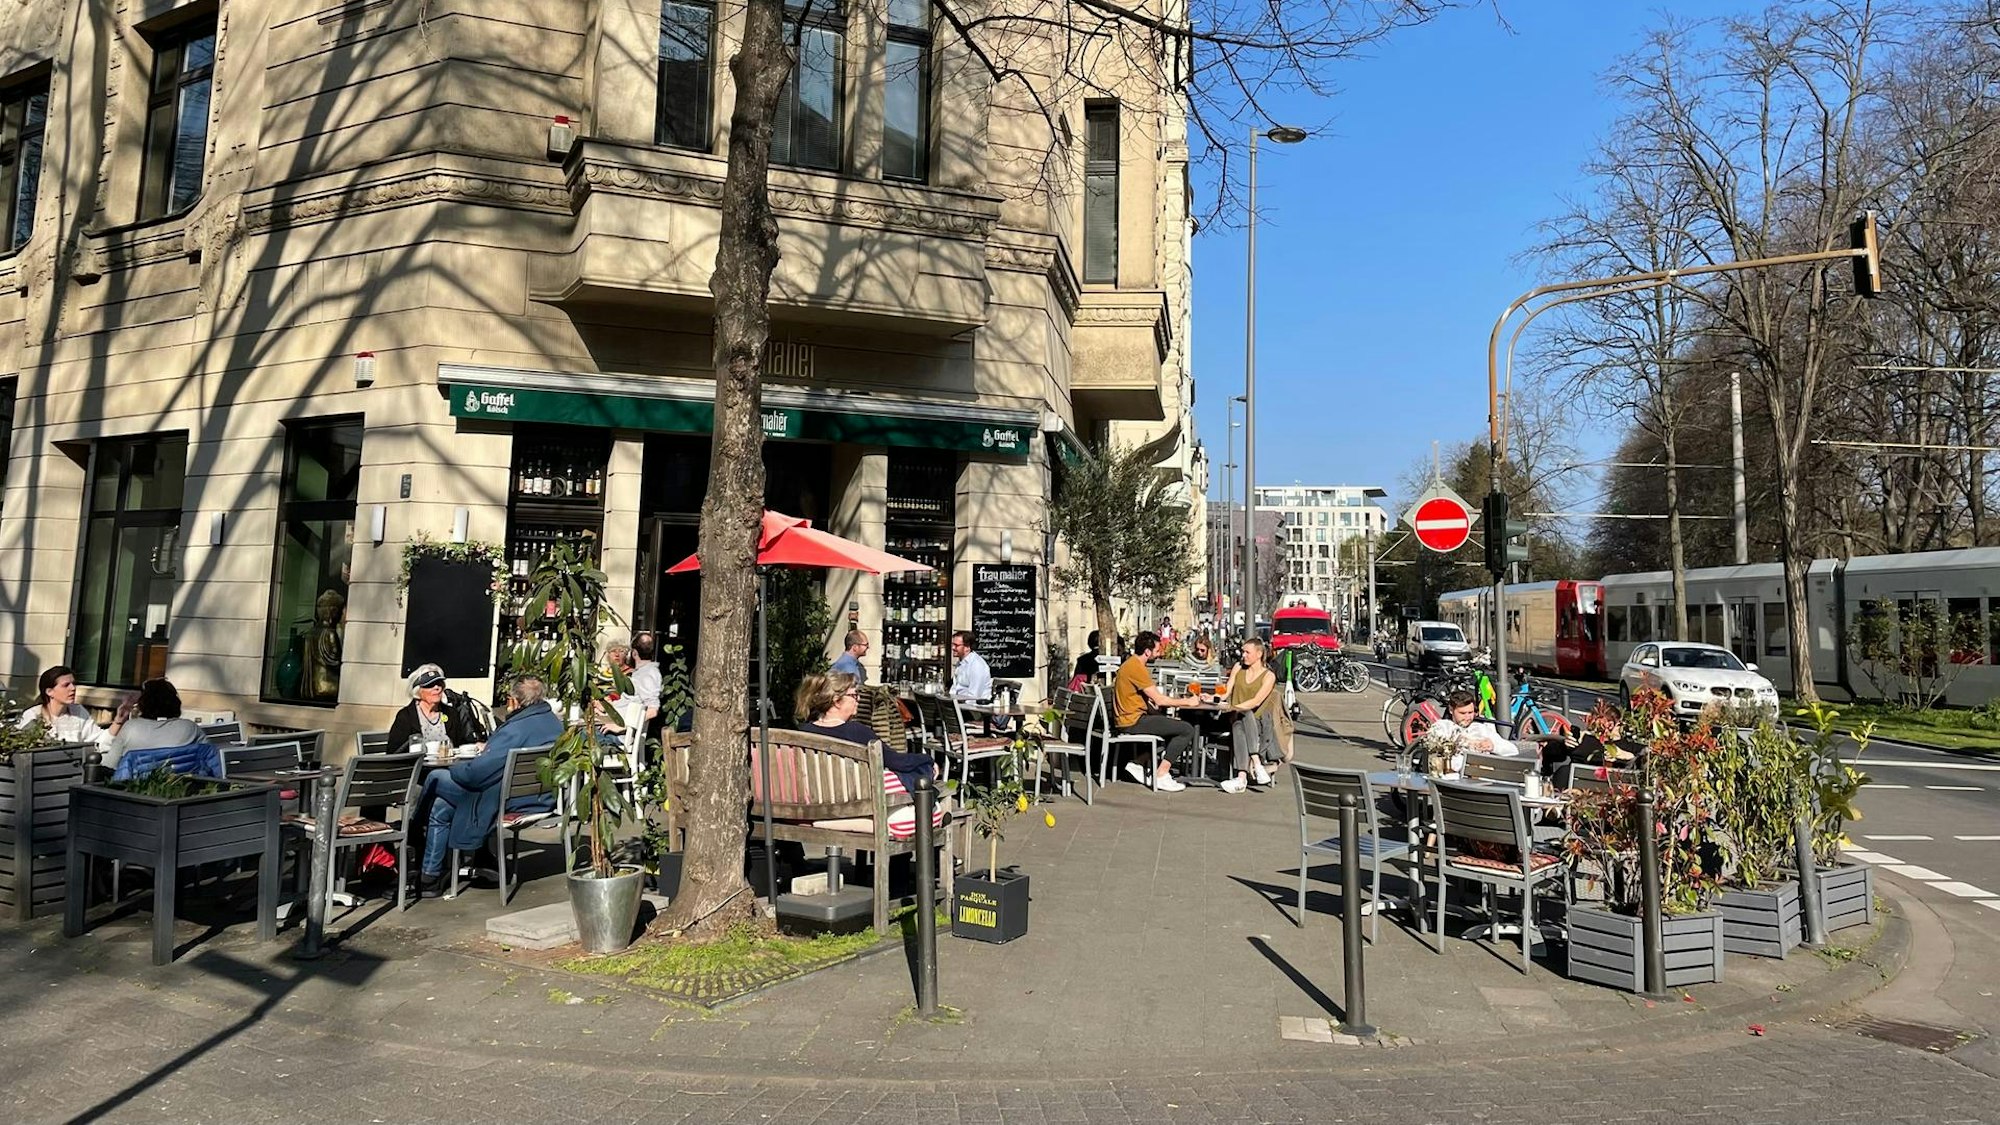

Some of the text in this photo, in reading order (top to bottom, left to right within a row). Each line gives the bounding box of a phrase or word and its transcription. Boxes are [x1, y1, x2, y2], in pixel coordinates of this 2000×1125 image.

[481, 392, 515, 406] Gaffel
[994, 429, 1020, 442] Gaffel
[978, 566, 998, 581] frau
[959, 894, 997, 906] PASQUALE
[971, 891, 987, 899] DON
[959, 905, 997, 928] LIMONCELLO
